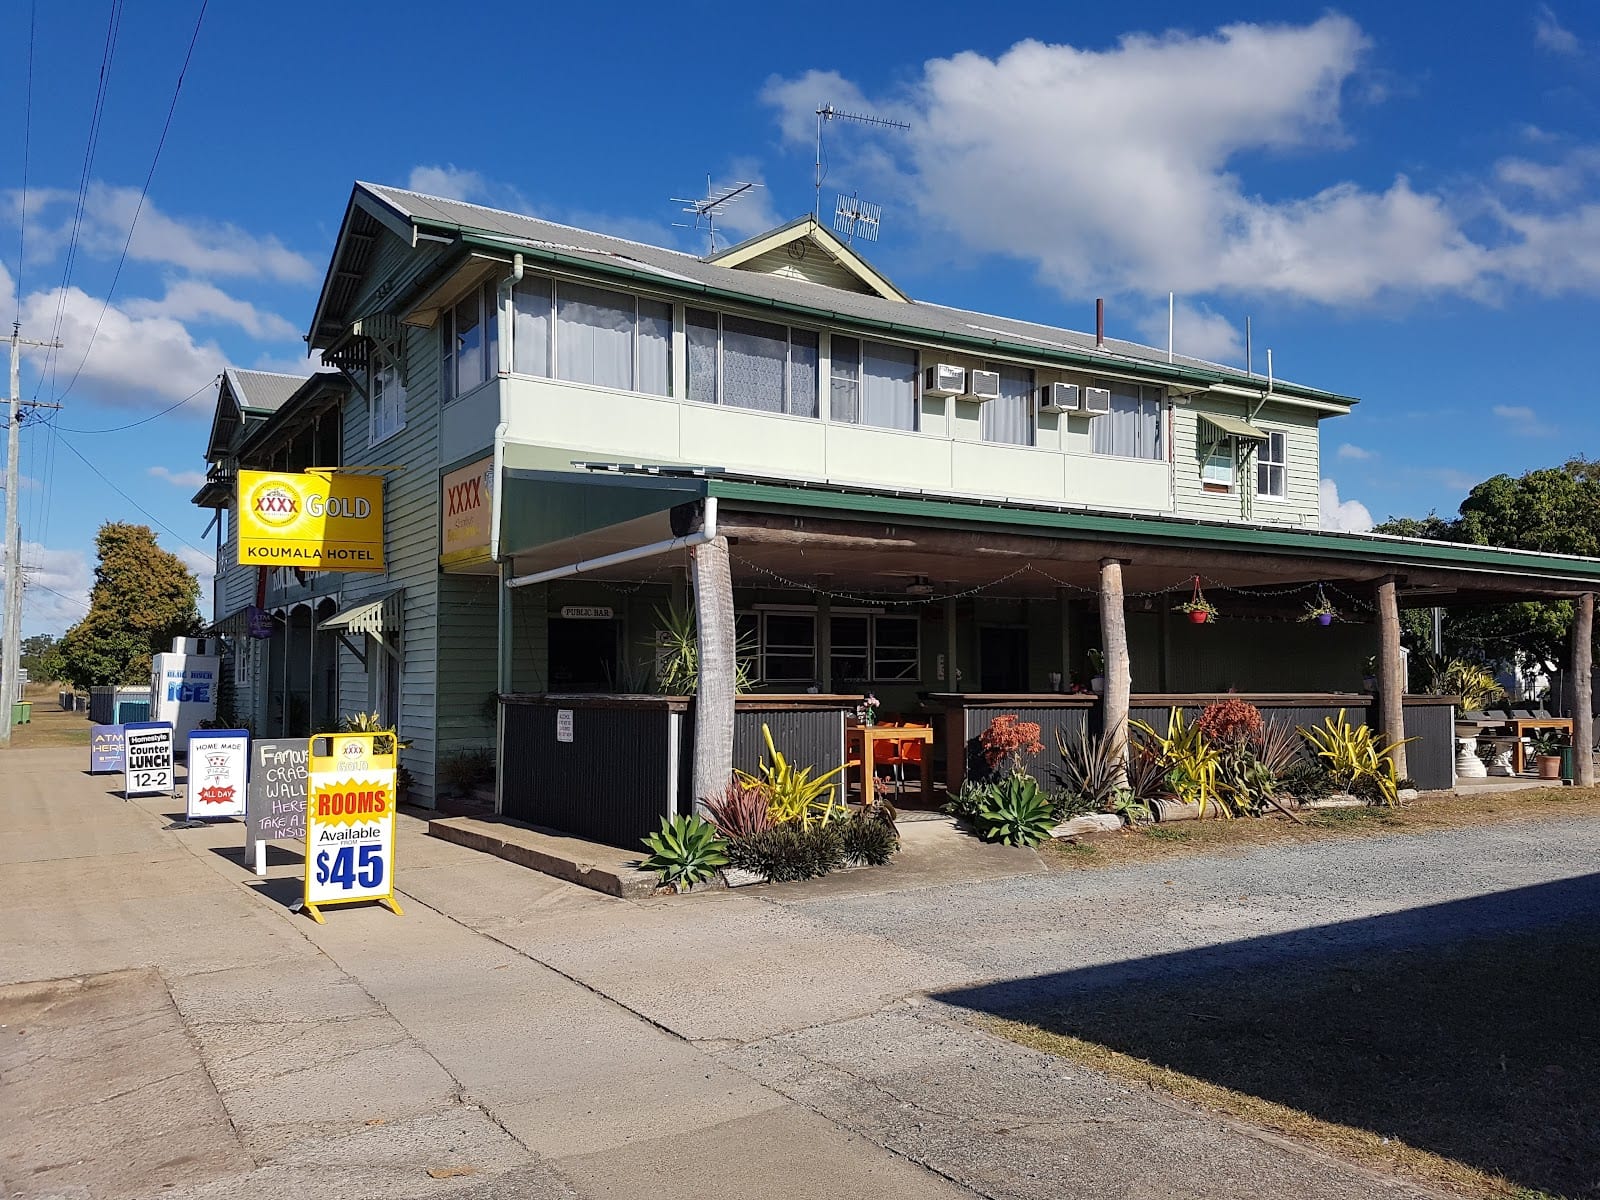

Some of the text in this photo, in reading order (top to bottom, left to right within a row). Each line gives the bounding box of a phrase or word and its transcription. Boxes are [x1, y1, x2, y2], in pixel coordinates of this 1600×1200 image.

[448, 475, 481, 517] XXXX
[255, 497, 298, 513] XXXX
[306, 493, 371, 519] GOLD
[248, 547, 374, 560] KOUMALA HOTEL
[566, 608, 609, 617] PUBLIC BAR
[167, 681, 210, 703] ICE
[95, 734, 124, 743] ATM
[131, 734, 167, 744] Homestyle
[93, 744, 125, 753] HERE
[130, 745, 169, 755] Counter
[196, 743, 242, 751] HOME MADE
[129, 754, 170, 769] LUNCH
[337, 761, 369, 772] GOLD
[133, 772, 167, 787] 12-2
[266, 766, 309, 783] CRAB
[203, 789, 232, 798] ALL DAY
[266, 784, 308, 798] WALL
[272, 800, 308, 814] HERE
[318, 790, 386, 816] ROOMS
[259, 818, 286, 830] TAKE
[291, 815, 300, 826] A
[275, 827, 306, 839] INSID
[319, 827, 381, 842] Available
[316, 845, 383, 890] $45
